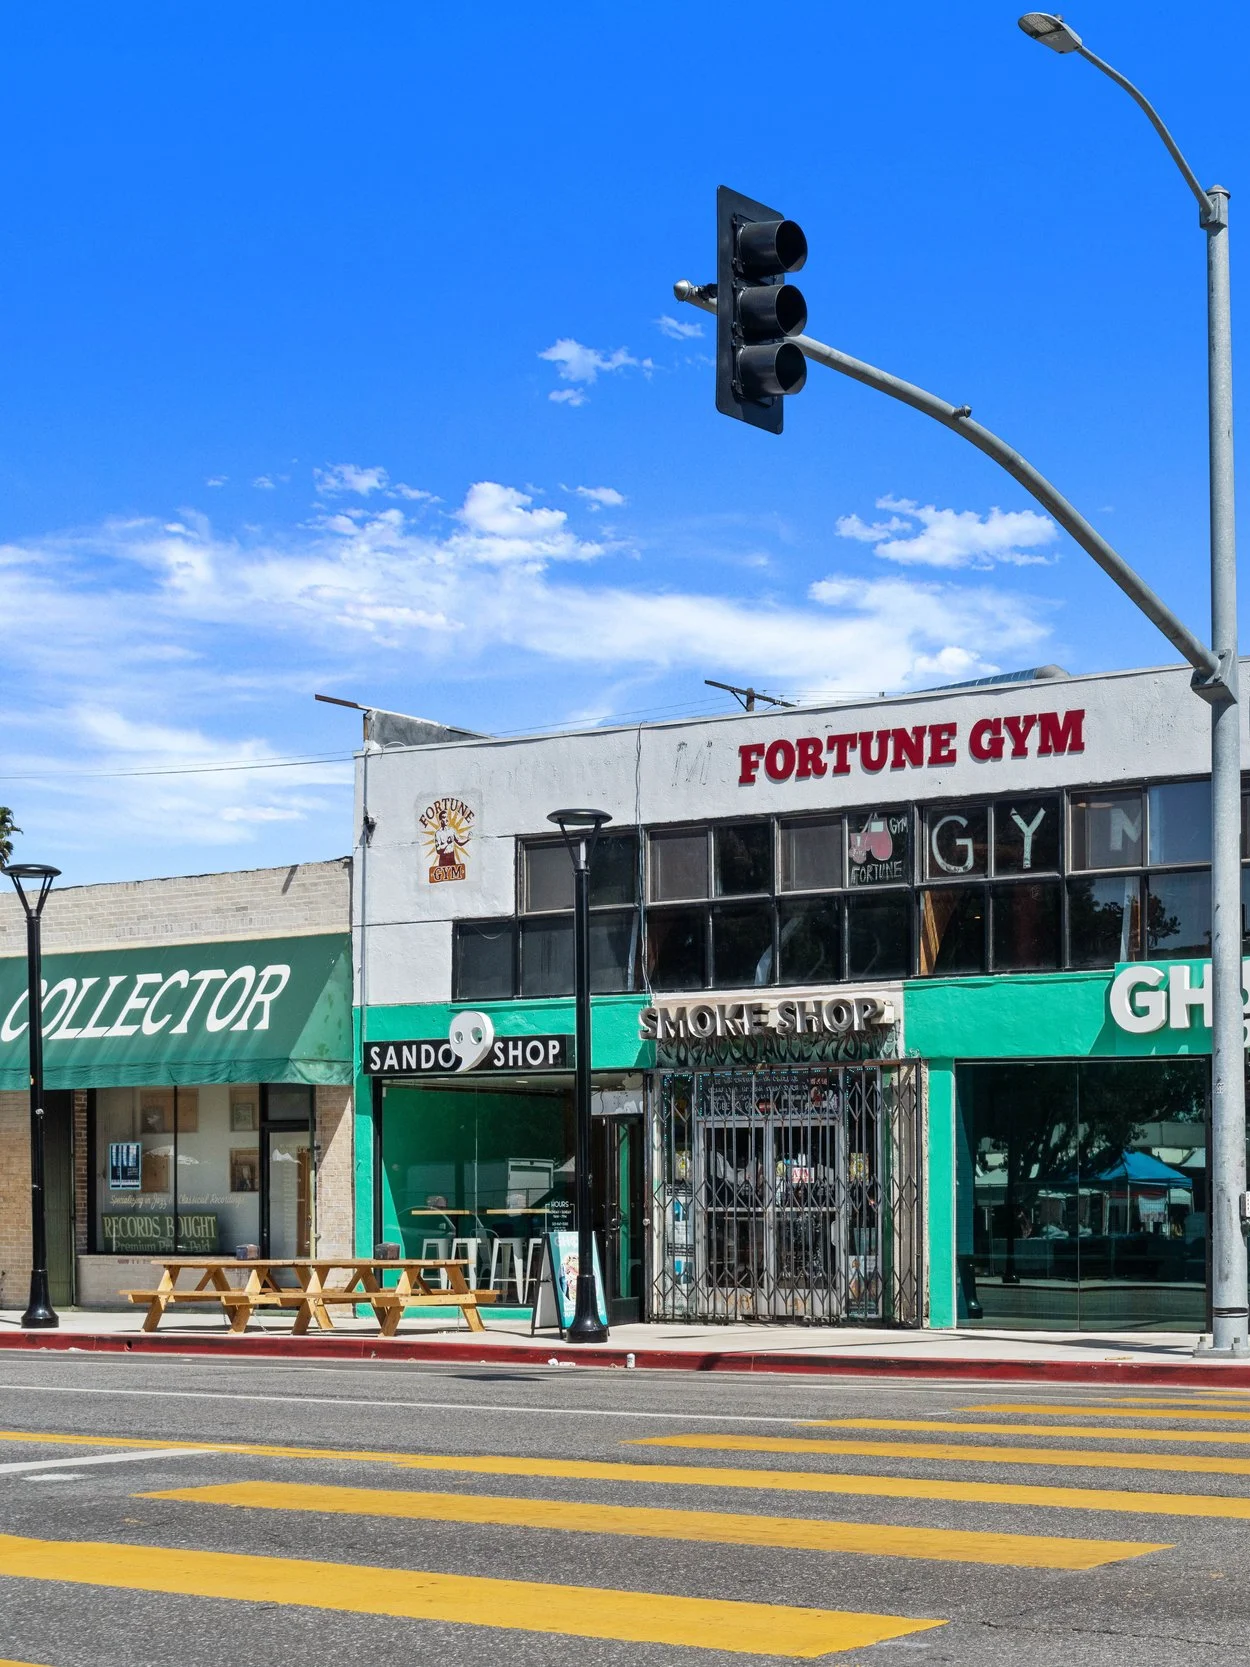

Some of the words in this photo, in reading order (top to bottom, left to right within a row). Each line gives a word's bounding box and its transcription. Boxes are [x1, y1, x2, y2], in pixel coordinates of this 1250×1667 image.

[738, 722, 958, 785] FORTUNE
[968, 709, 1086, 761] GYM
[418, 798, 475, 828] FORTUNE
[889, 816, 909, 835] GYM
[433, 865, 462, 881] GYM
[851, 861, 902, 886] FORTUNE
[1, 964, 291, 1042] COLLECTOR
[638, 1002, 770, 1041] SMOKE
[775, 997, 882, 1036] SHOP
[369, 1043, 456, 1071] SANDO
[493, 1040, 560, 1067] SHOP
[103, 1216, 161, 1238] RECORDS
[166, 1216, 216, 1239] BOUGHT
[115, 1240, 156, 1252] Premium
